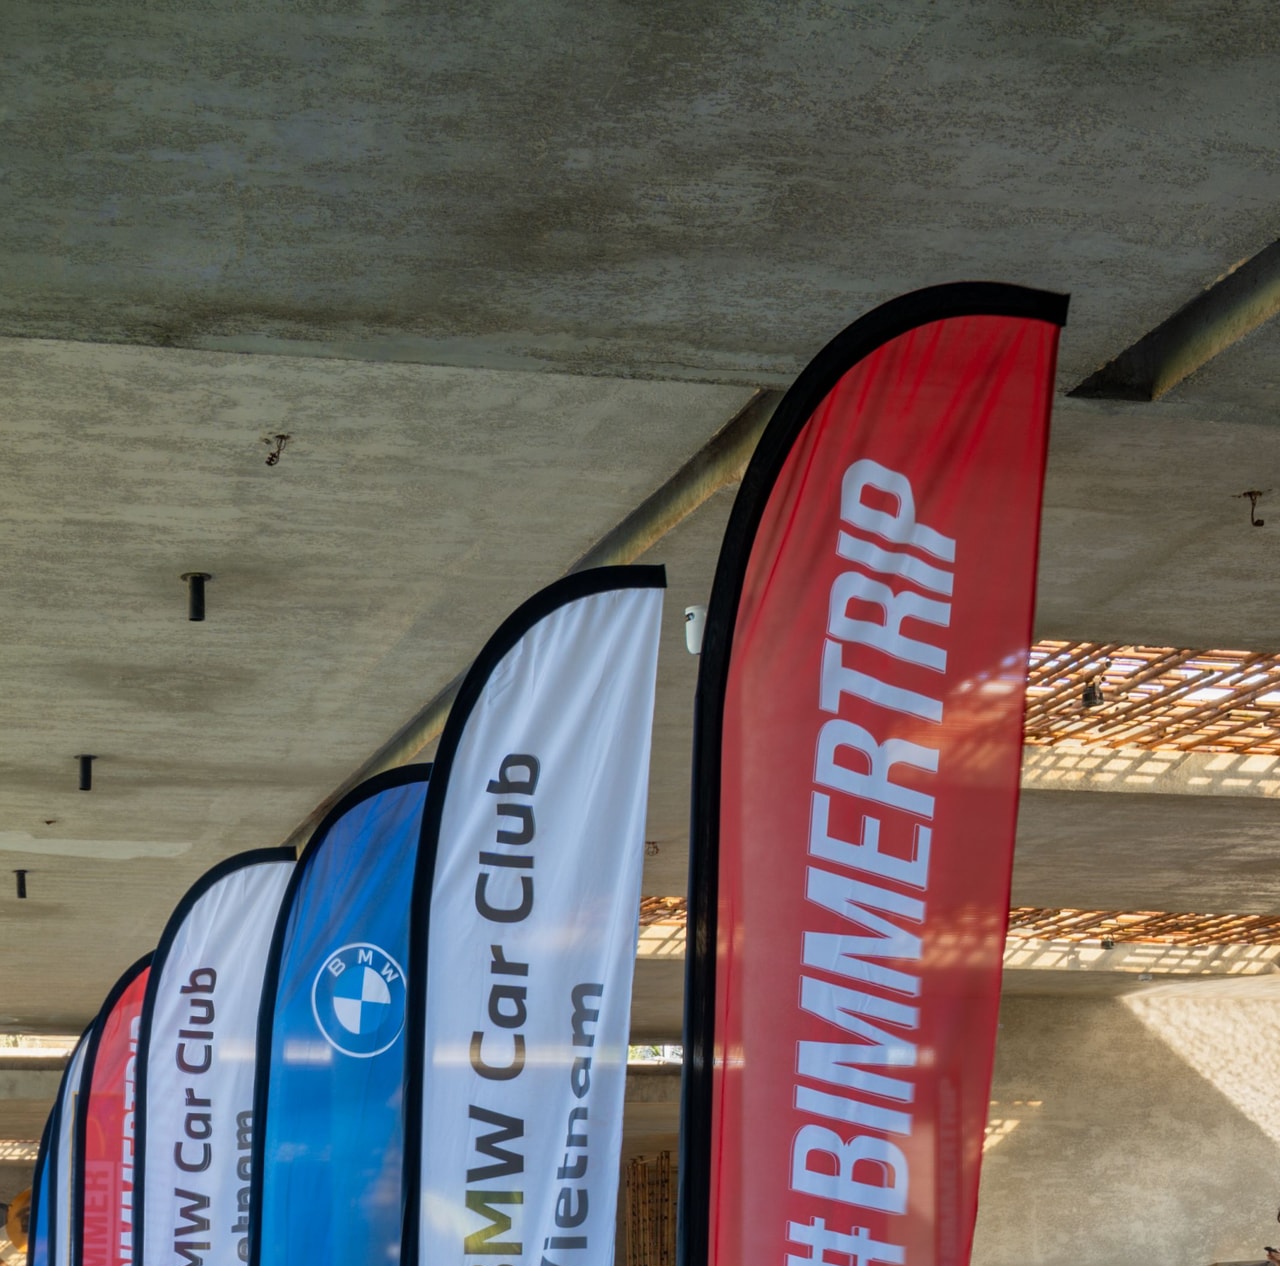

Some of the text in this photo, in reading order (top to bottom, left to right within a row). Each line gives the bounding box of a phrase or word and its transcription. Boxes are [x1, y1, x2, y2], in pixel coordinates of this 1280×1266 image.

[475, 753, 541, 924] Club
[327, 948, 400, 983] BMW
[469, 944, 530, 1082] Car
[175, 967, 218, 1075] Club
[173, 1087, 213, 1173] Car
